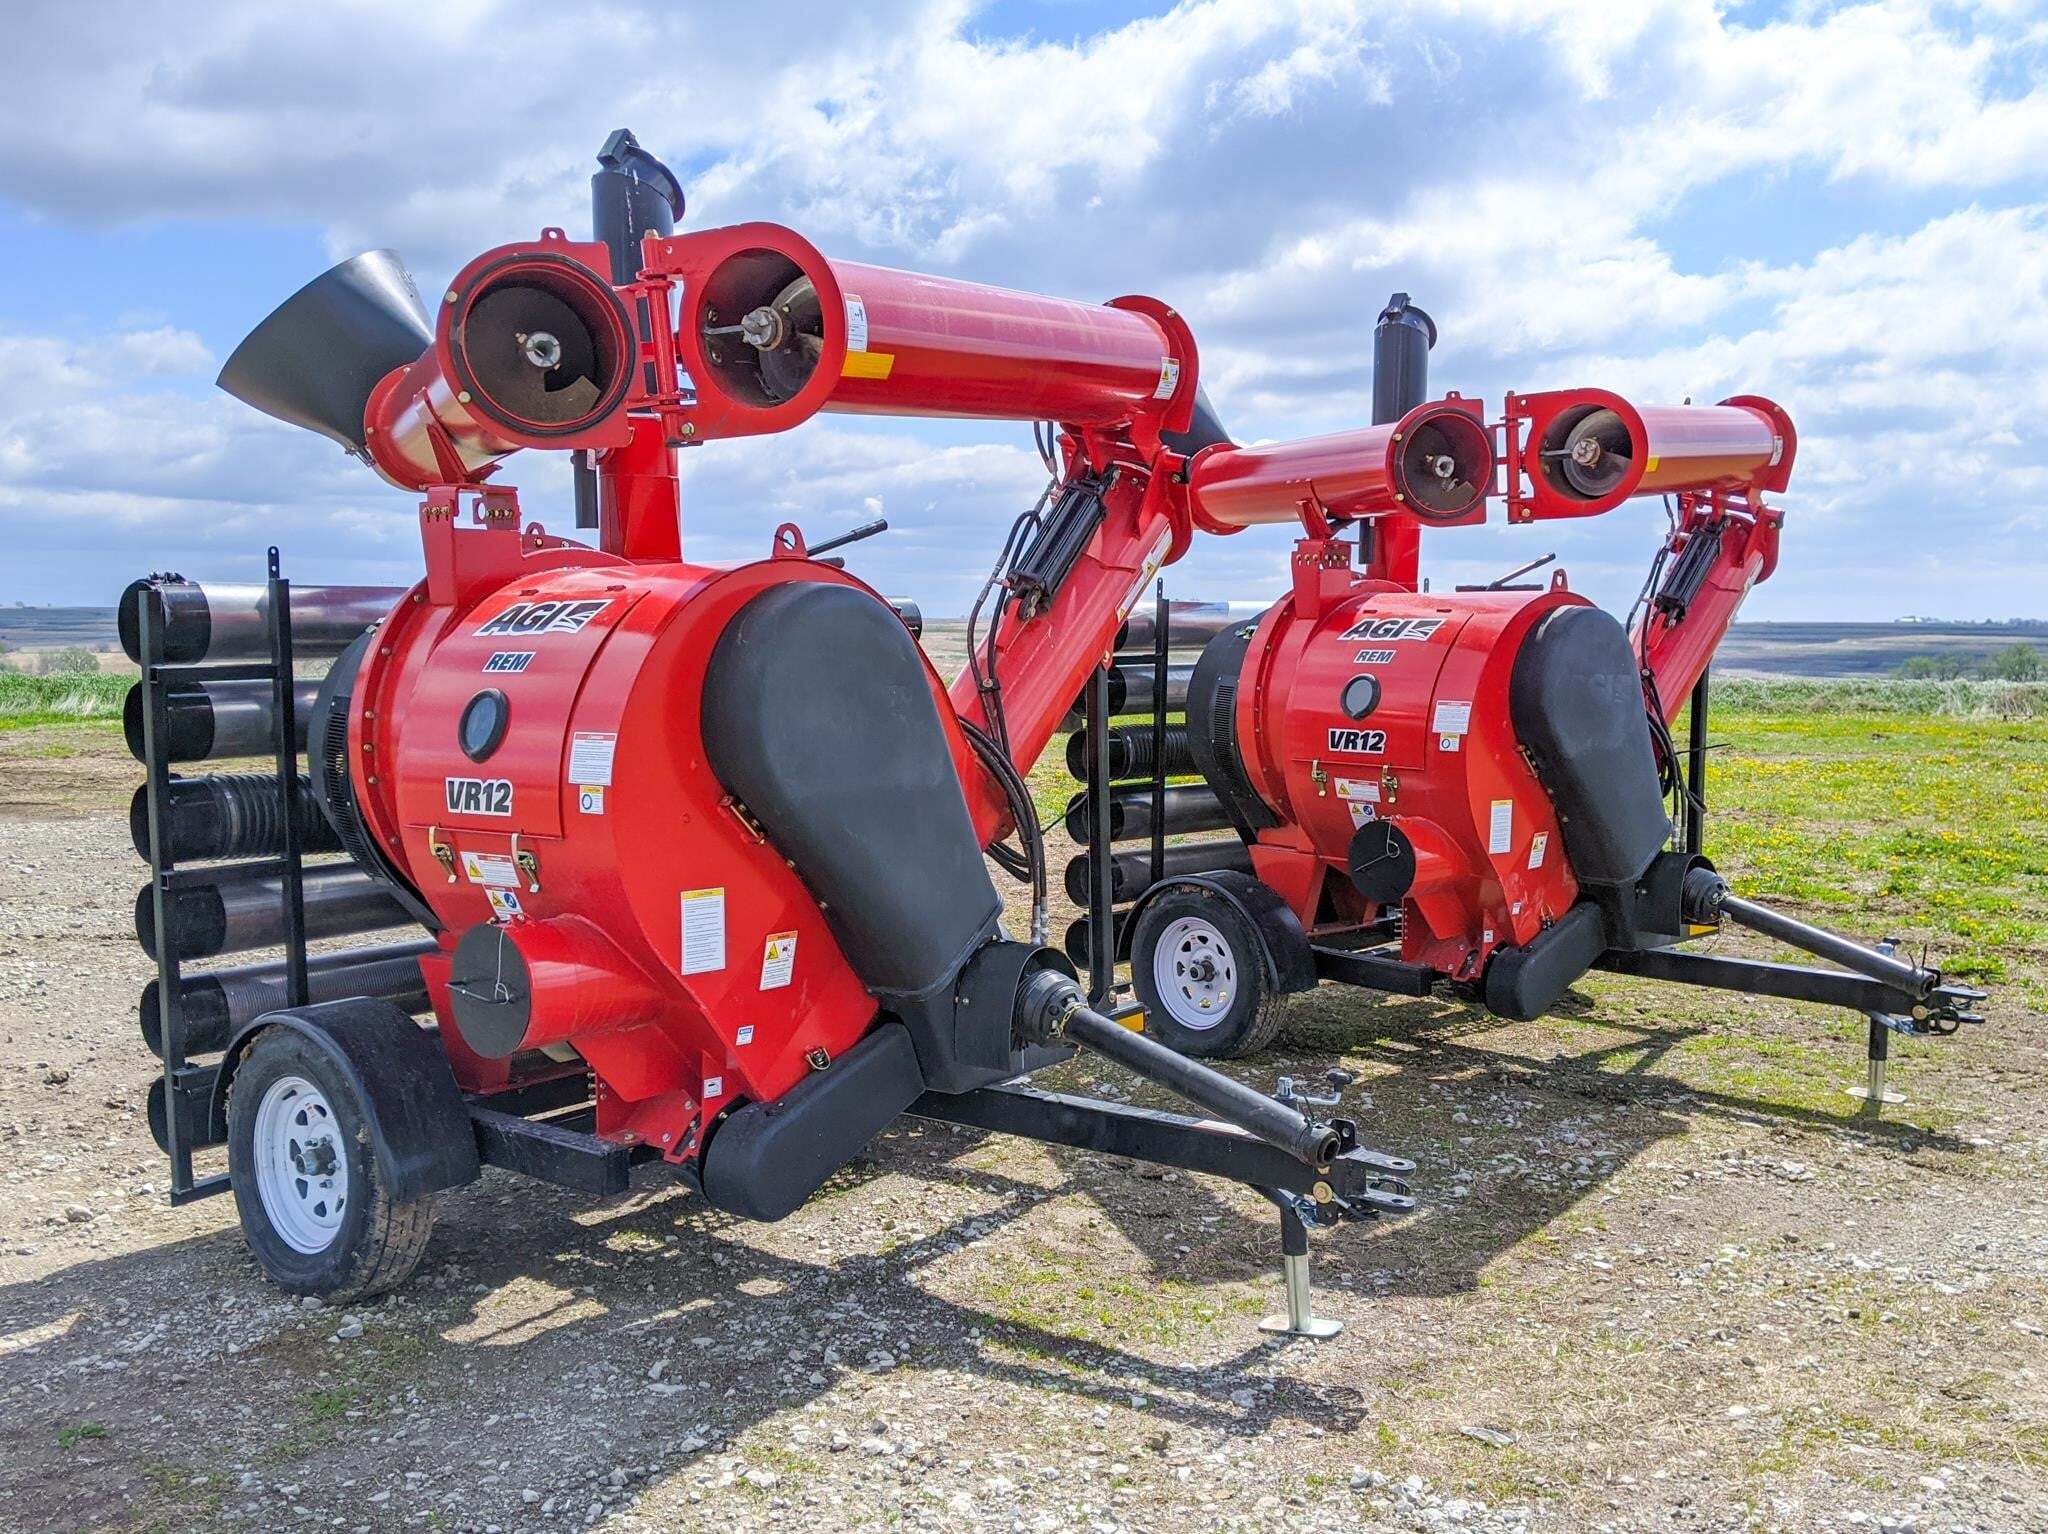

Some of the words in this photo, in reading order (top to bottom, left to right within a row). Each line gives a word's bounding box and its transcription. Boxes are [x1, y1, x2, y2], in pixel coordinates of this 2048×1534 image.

[479, 603, 574, 633] AGI
[1341, 620, 1414, 639] AGI
[485, 653, 534, 671] REM
[1355, 651, 1395, 662] REM
[1330, 730, 1385, 752] VR12
[447, 780, 511, 813] VR12
